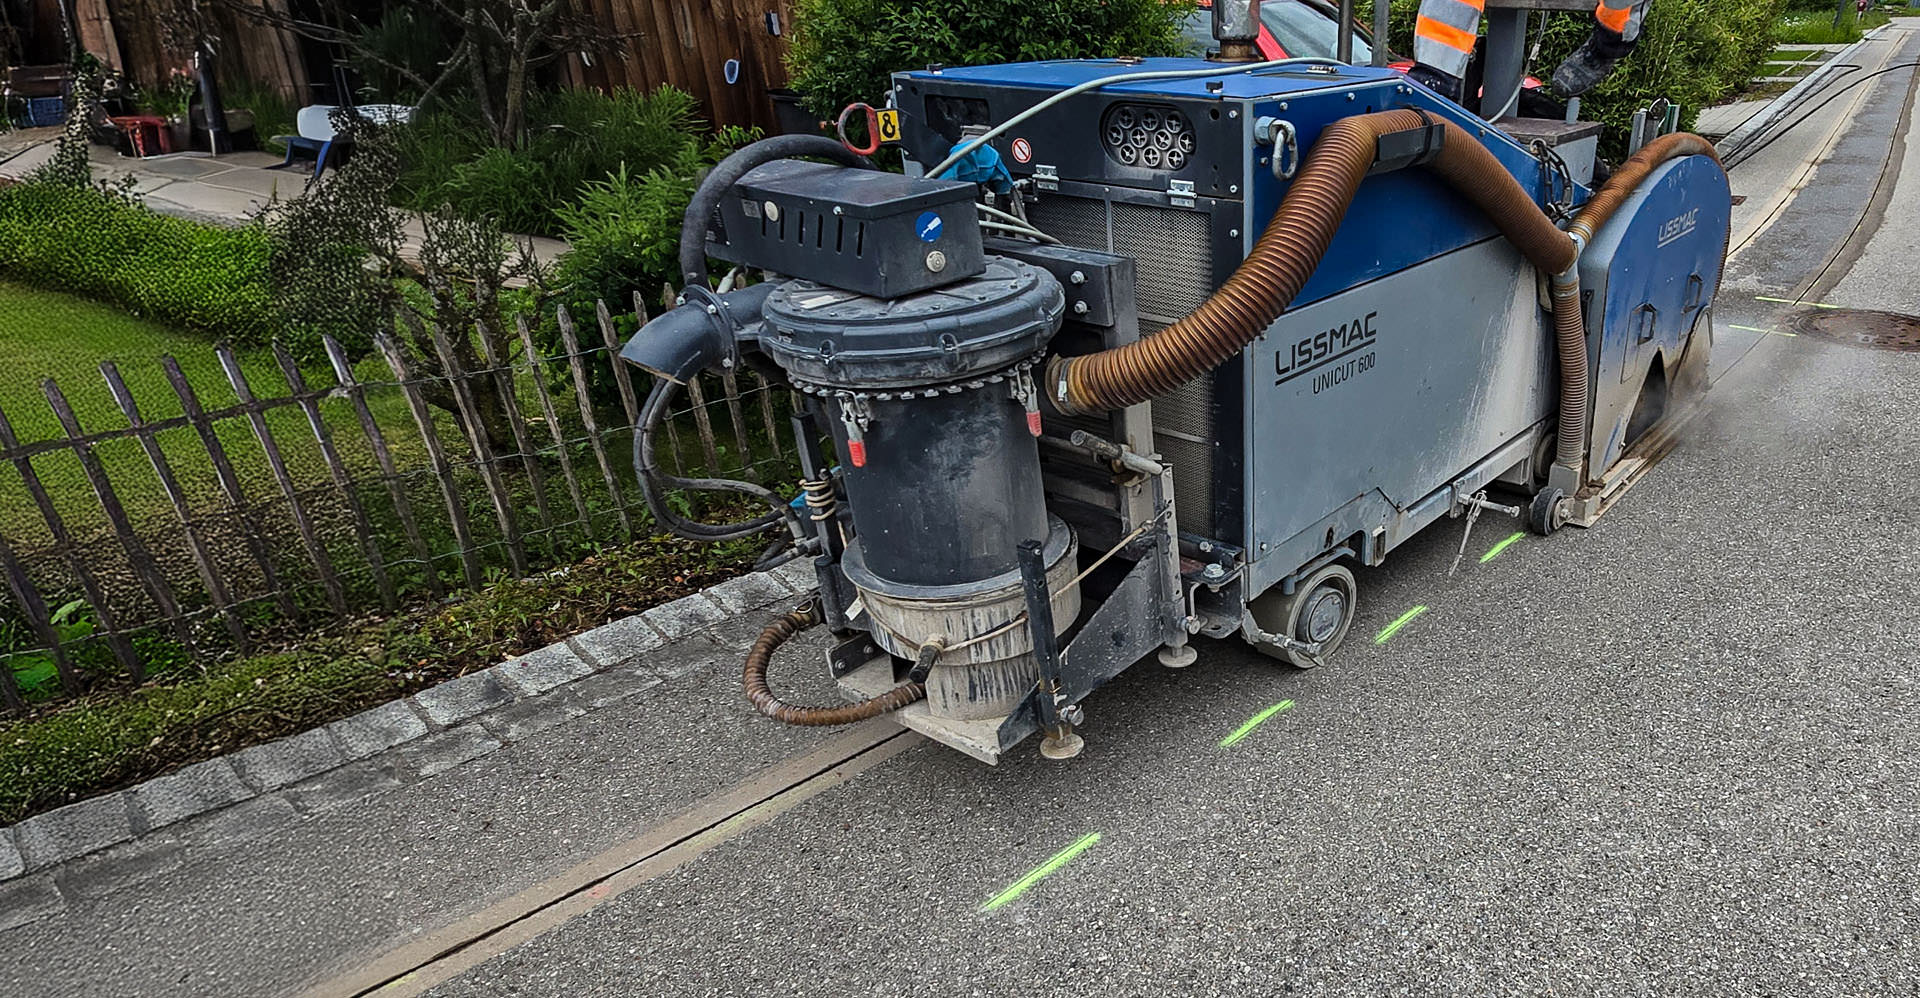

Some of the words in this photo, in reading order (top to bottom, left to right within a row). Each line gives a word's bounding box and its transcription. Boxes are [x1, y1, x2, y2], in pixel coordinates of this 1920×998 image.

[1659, 208, 1699, 242] LISSMAC
[1275, 311, 1377, 376] LISSMAC
[1313, 360, 1356, 394] UNICUT
[1358, 352, 1376, 374] 600
